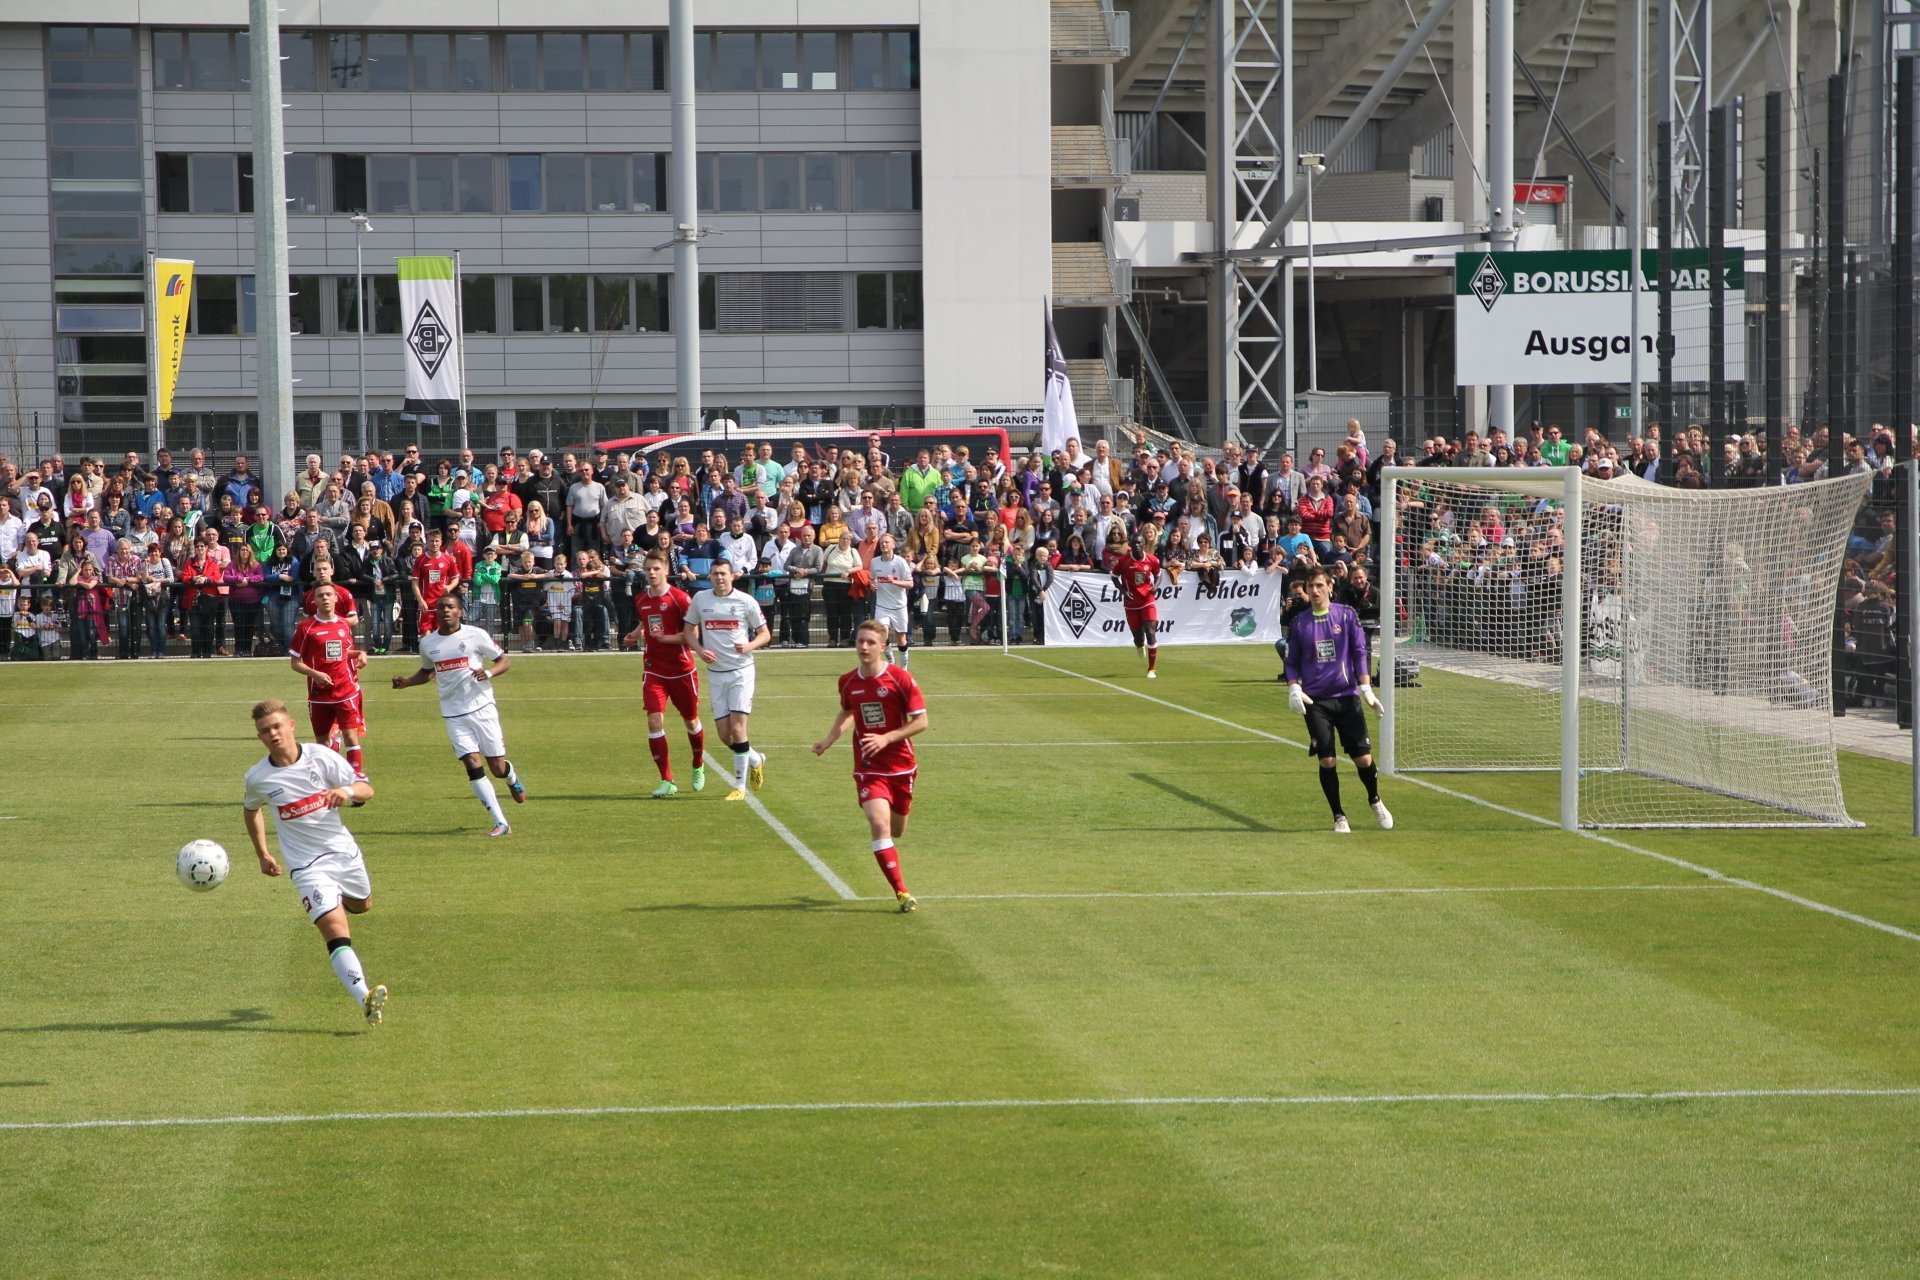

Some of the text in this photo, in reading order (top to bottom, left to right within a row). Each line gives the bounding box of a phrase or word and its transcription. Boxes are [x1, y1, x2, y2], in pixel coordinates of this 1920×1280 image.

[978, 416, 1028, 424] EINGANG
[1195, 580, 1260, 600] Fohlen
[1102, 619, 1126, 632] on
[290, 796, 325, 816] Santande
